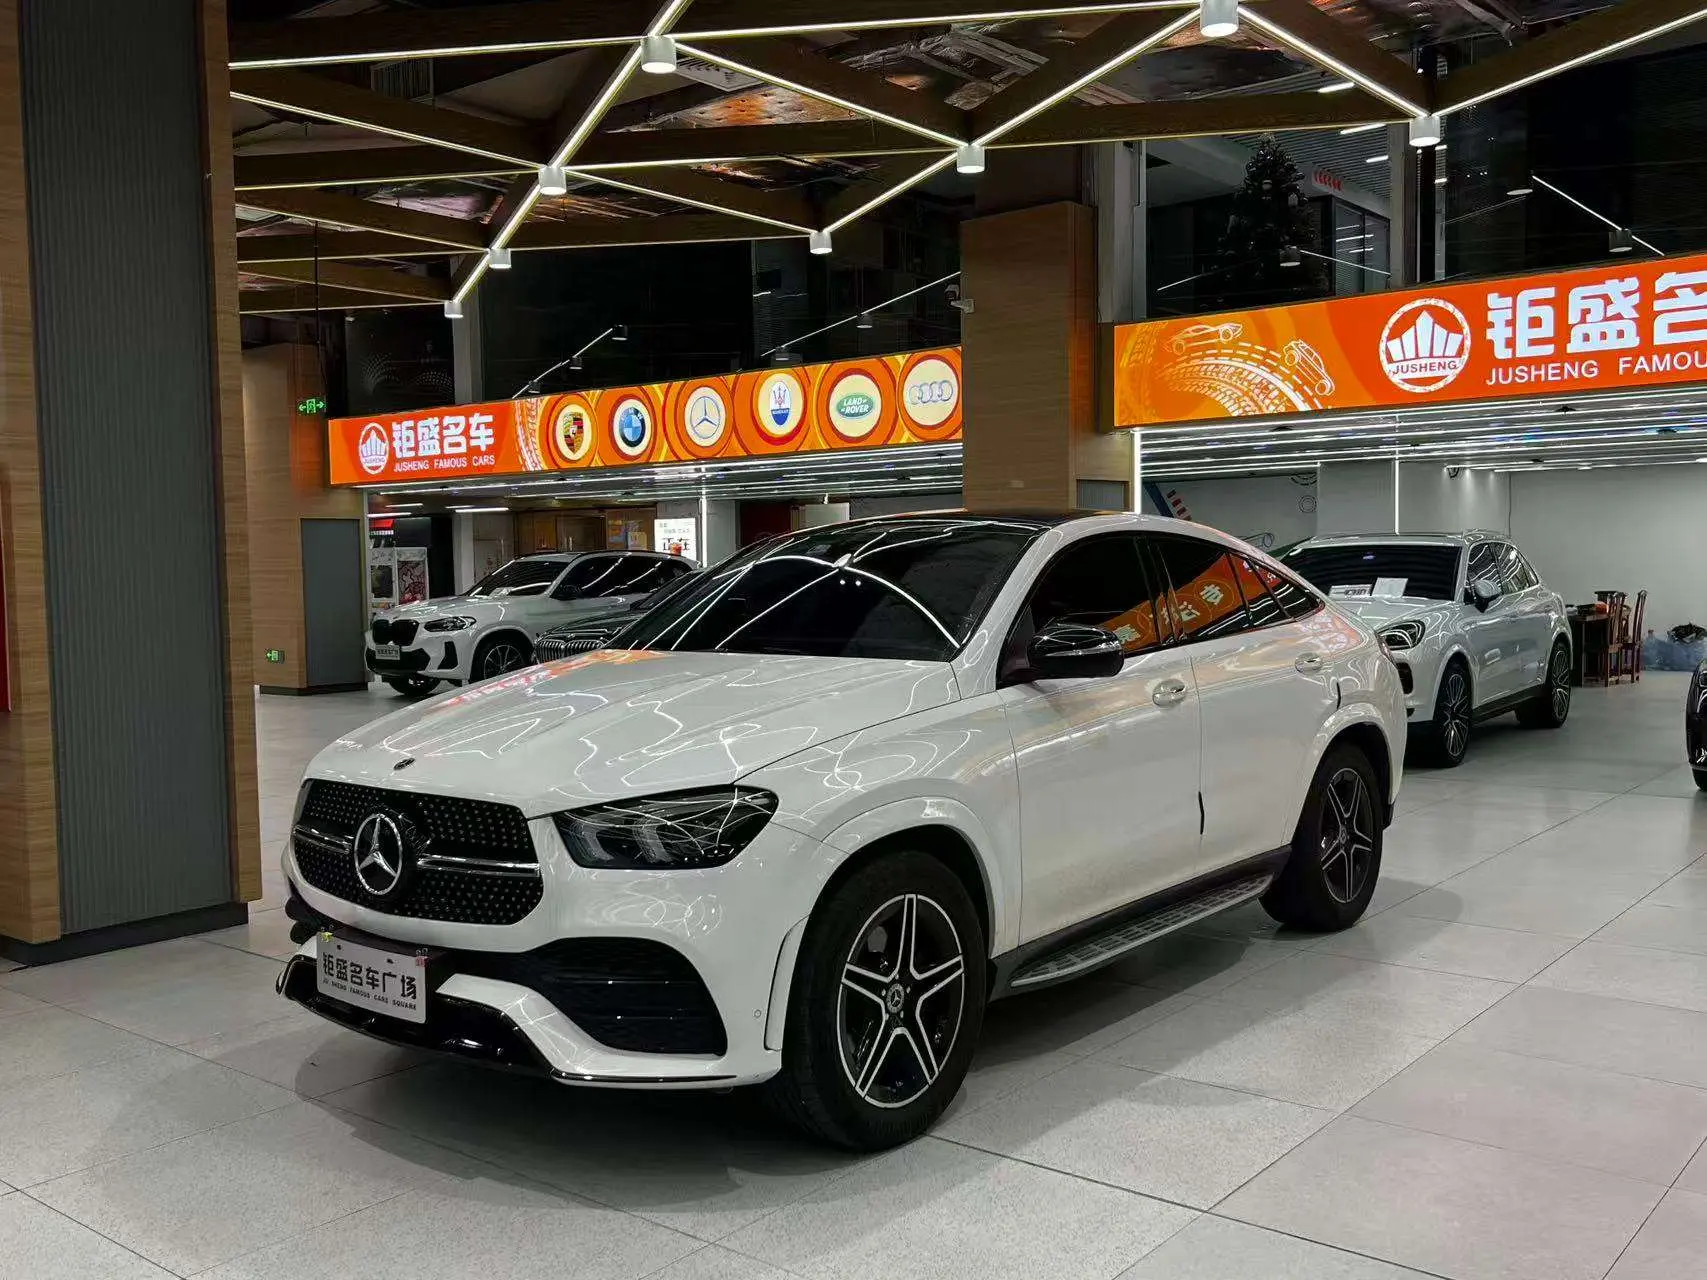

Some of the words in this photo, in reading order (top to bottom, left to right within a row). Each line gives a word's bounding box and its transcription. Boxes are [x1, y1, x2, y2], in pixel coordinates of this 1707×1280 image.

[1485, 271, 1707, 359] 钜盛名
[1391, 359, 1458, 375] JUSHENG
[1485, 359, 1599, 386] JUSHENG
[843, 397, 863, 407] LAND
[844, 404, 870, 414] ROVER
[391, 412, 495, 459] 钜盛名车
[393, 459, 430, 473] JUSHENG
[433, 456, 468, 469] FAMOUS
[472, 454, 496, 467] CARS
[322, 951, 417, 1000] 钜盛名车广场
[349, 986, 371, 999] FAMOUS
[373, 994, 389, 1004] CARS
[392, 998, 417, 1011] SQUARE
